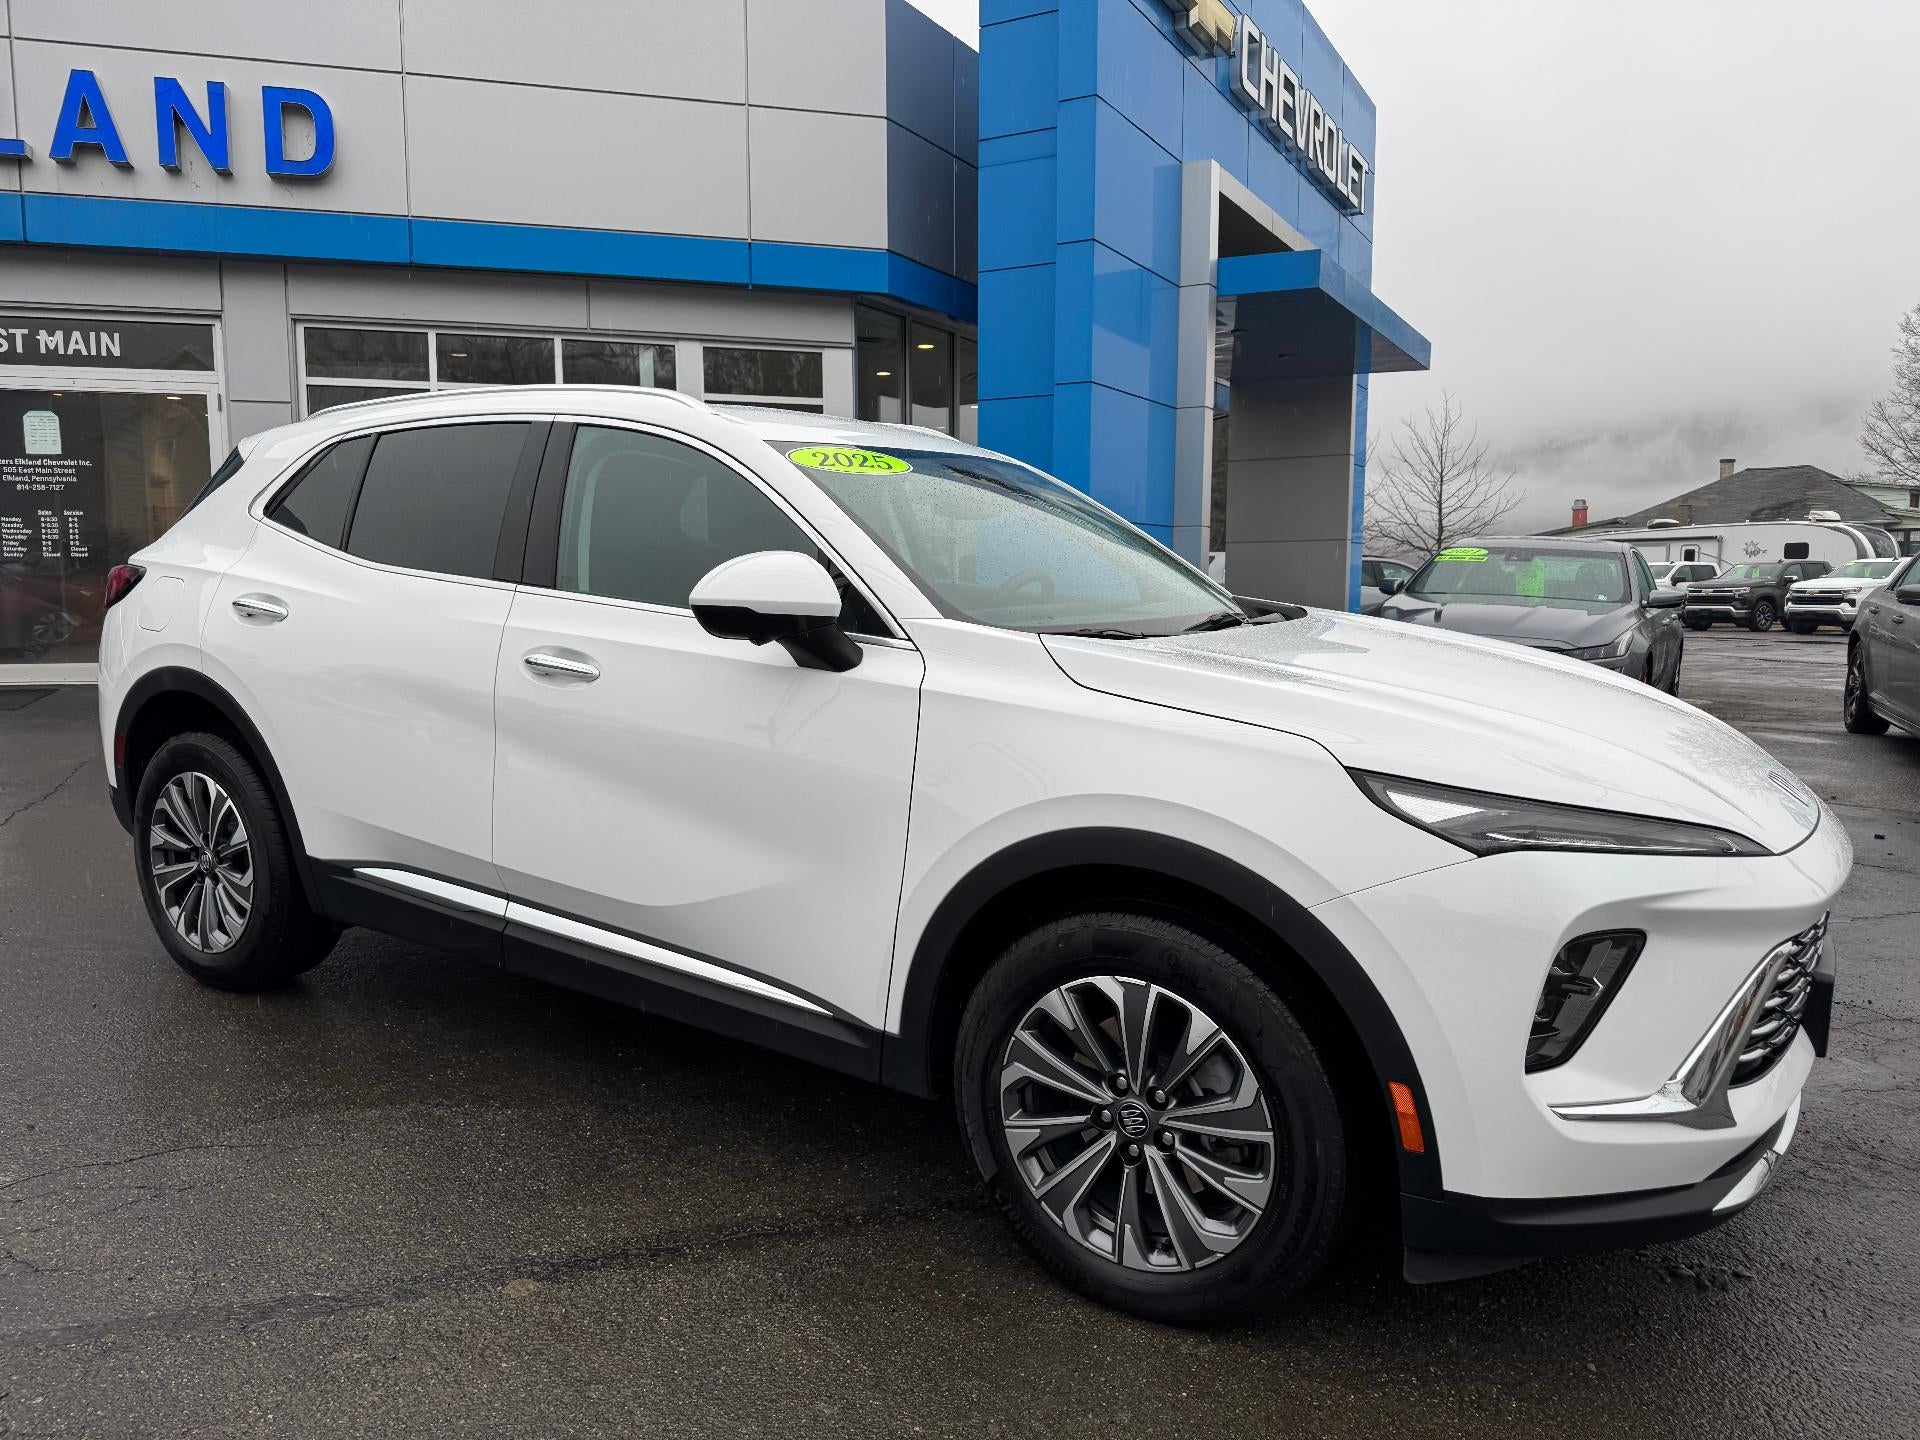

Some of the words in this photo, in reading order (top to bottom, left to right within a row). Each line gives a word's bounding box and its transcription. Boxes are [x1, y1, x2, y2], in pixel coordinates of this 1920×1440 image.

[1231, 14, 1369, 215] CHEVROLET
[38, 329, 121, 357] MAIN
[811, 451, 893, 470] 2025
